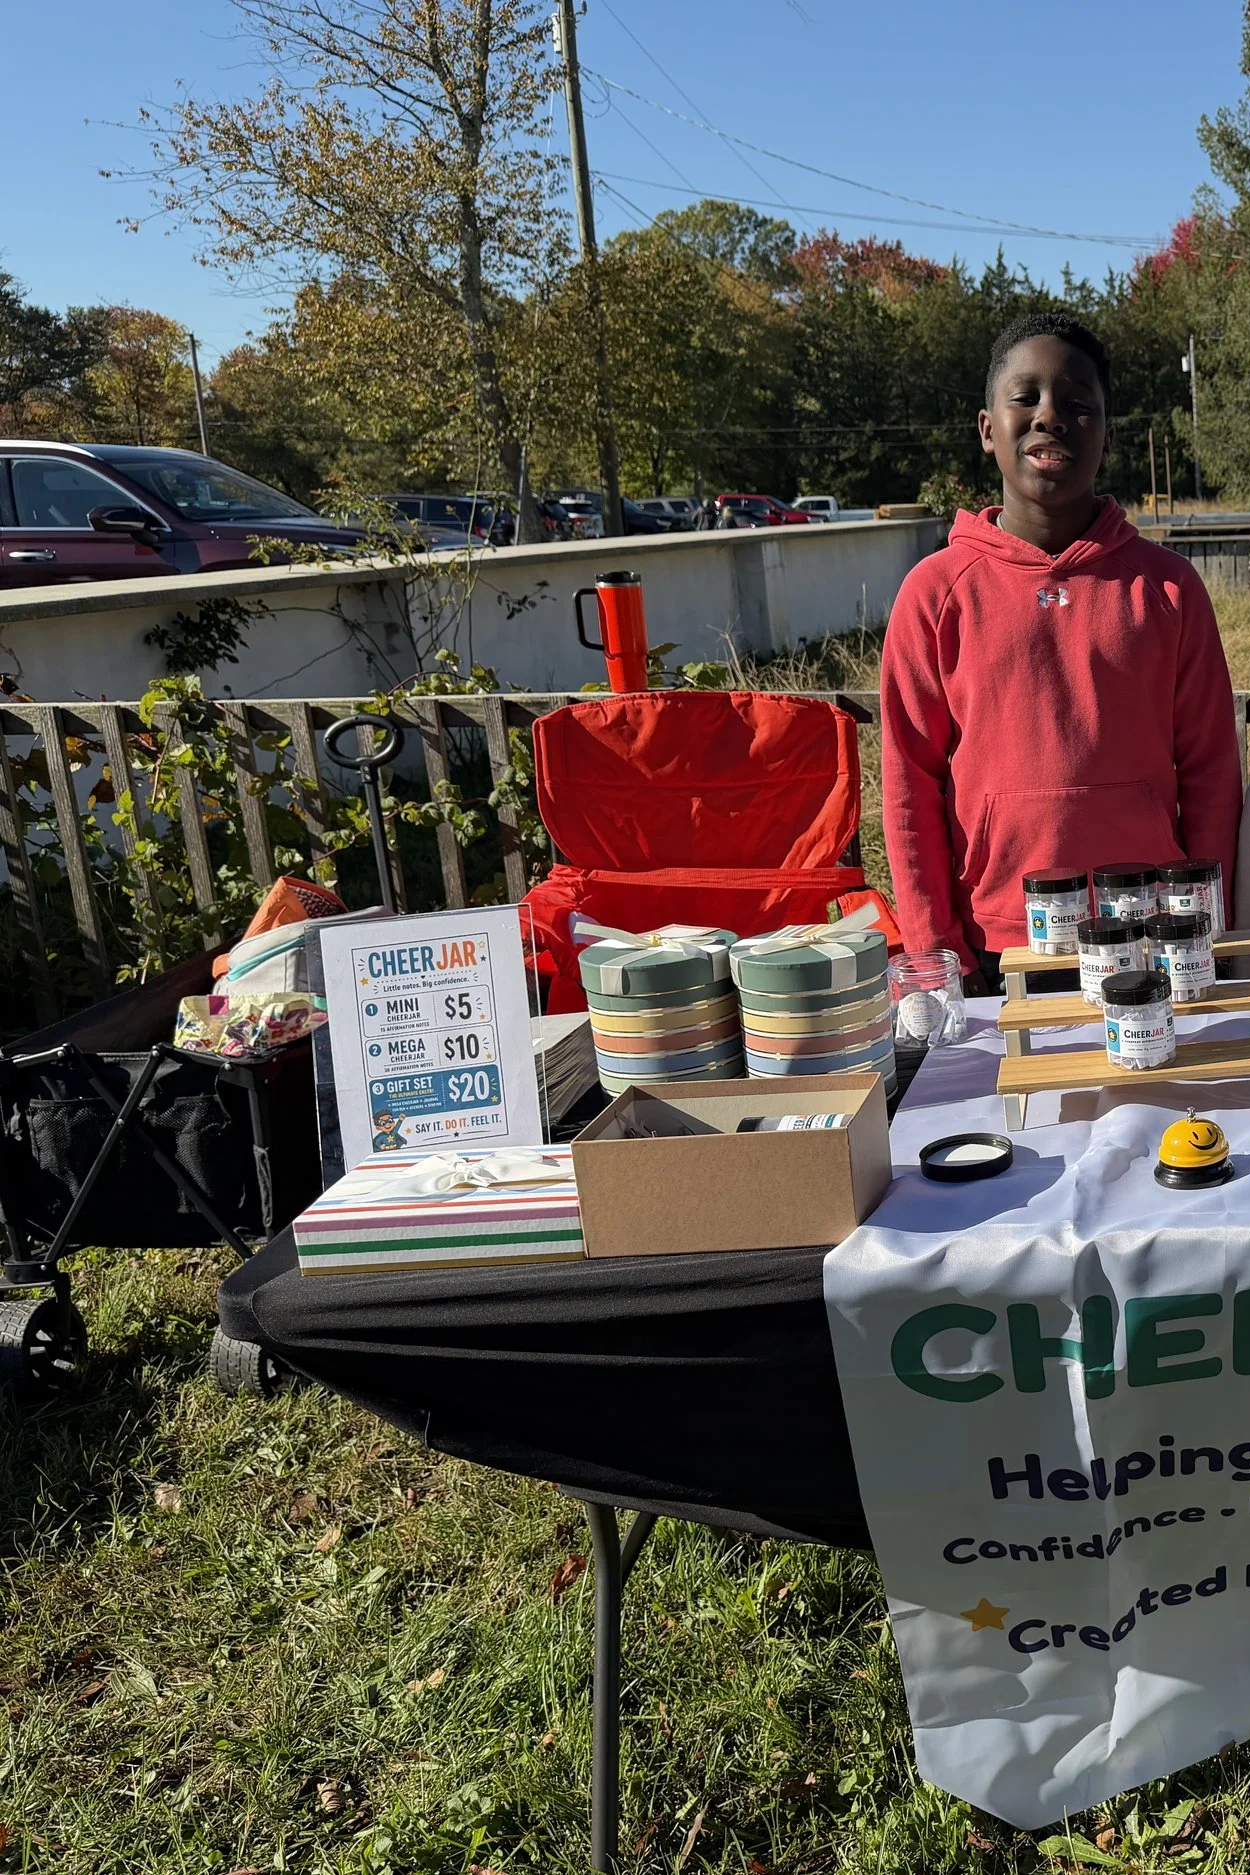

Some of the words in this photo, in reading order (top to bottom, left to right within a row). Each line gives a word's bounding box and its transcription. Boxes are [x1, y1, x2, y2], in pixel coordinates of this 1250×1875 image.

[368, 940, 478, 978] CHEERJAR
[383, 983, 400, 992] Little
[402, 982, 420, 990] notes.
[422, 980, 432, 988] Big
[434, 976, 470, 986] confidence.
[386, 997, 420, 1014] MINI
[444, 992, 472, 1020] $5
[387, 1012, 421, 1022] CHEERJAR
[386, 1024, 415, 1032] AFFIRMATION
[1124, 1028, 1164, 1038] CHEERJAR
[388, 1038, 426, 1055] MEGA
[444, 1034, 480, 1060] $10
[390, 1052, 425, 1062] CHEERJAR
[391, 1064, 419, 1072] AFFIRMATION
[387, 1079, 410, 1093] GIFT
[414, 1076, 432, 1090] SET
[448, 1071, 490, 1102] $20
[416, 1122, 432, 1134] SAY
[433, 1121, 443, 1132] IT.
[446, 1120, 457, 1129] DO
[459, 1118, 470, 1128] IT.
[471, 1115, 490, 1126] FEEL
[492, 1114, 502, 1124] IT.
[943, 1506, 1206, 1564] Confidence
[1008, 1566, 1227, 1653] Created
